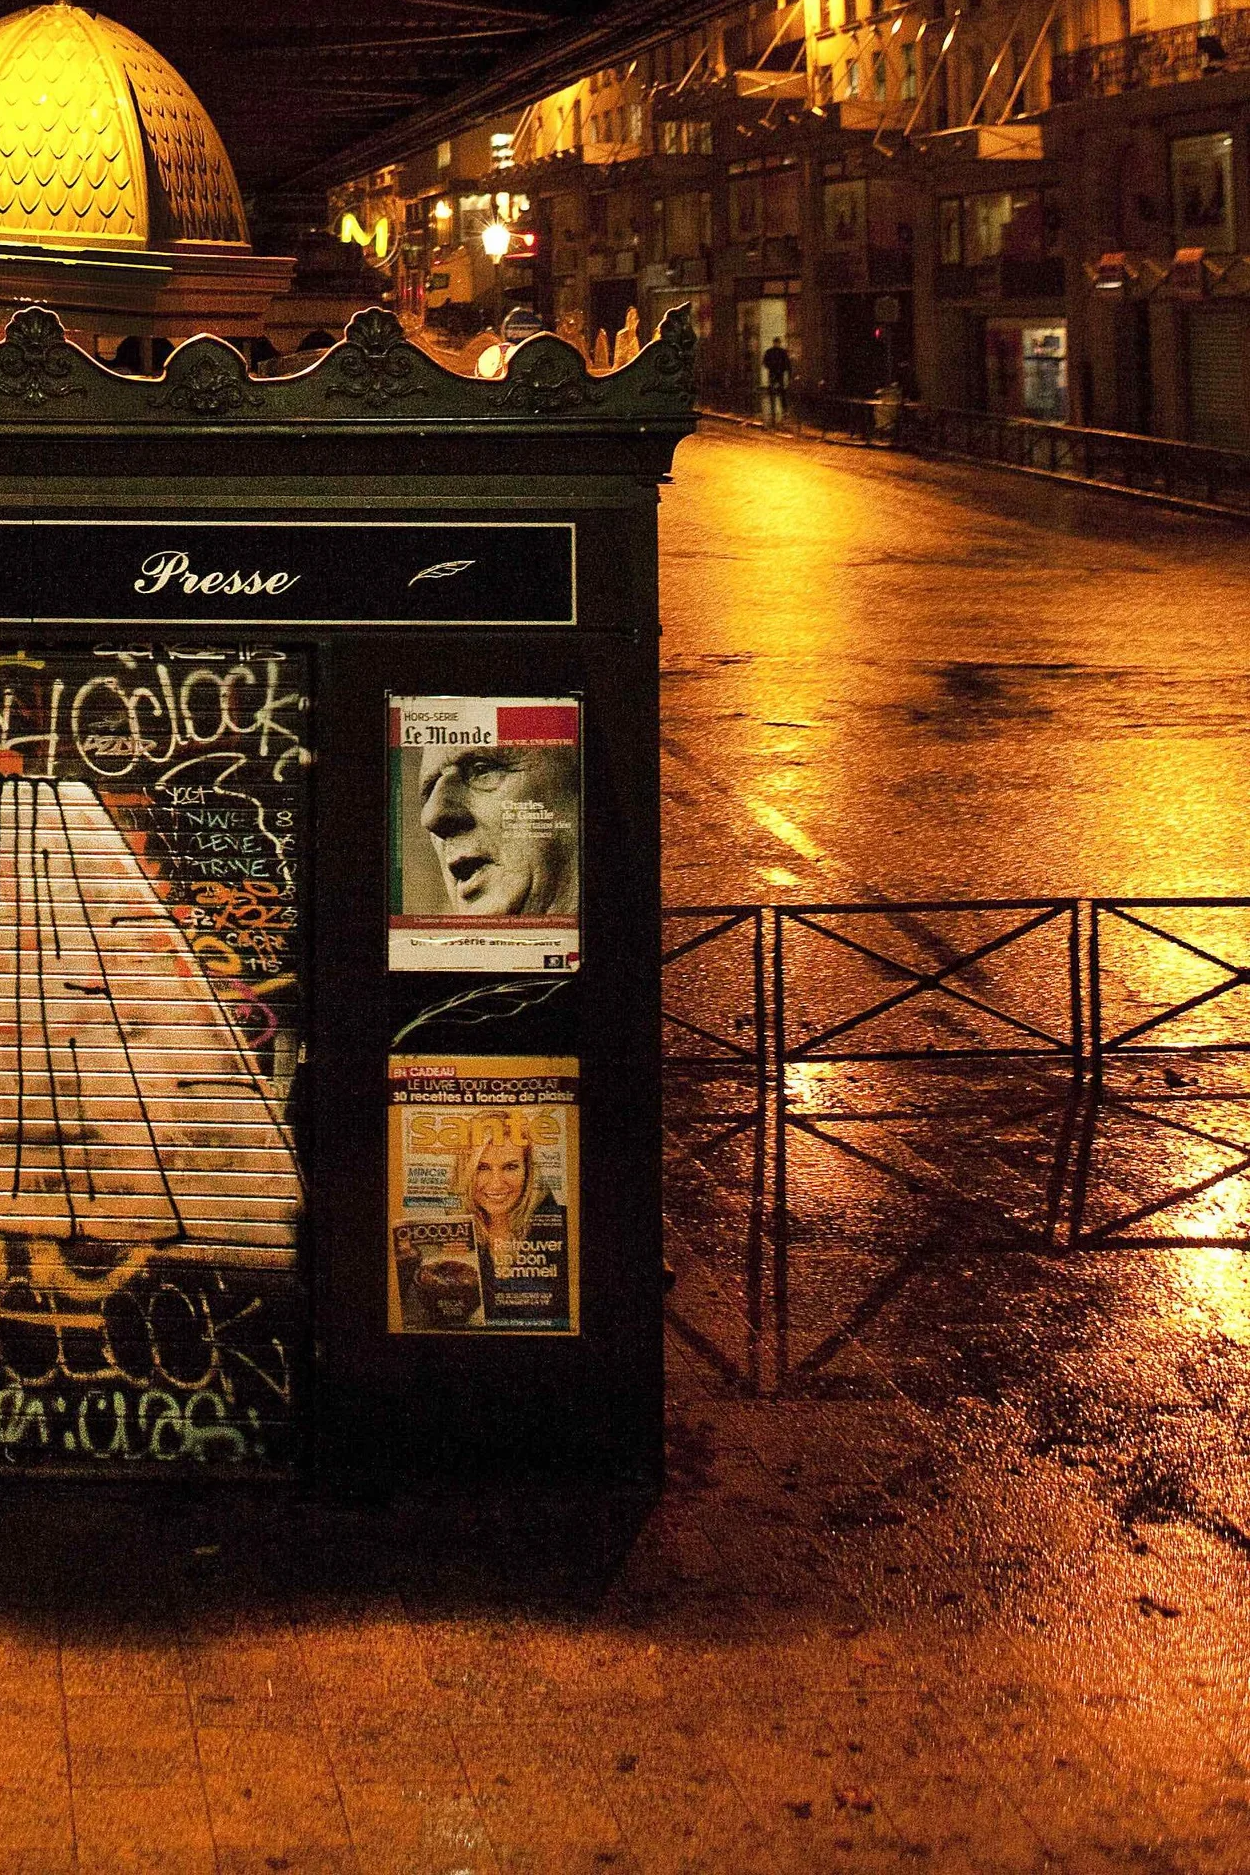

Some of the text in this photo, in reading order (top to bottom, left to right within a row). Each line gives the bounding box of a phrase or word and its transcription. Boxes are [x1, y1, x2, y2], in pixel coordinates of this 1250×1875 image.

[133, 550, 301, 597] Presse
[404, 725, 492, 745] Le Monde
[409, 1067, 456, 1077] CADEAU
[407, 1079, 559, 1091] LE LIVRE TOUT CHOCOLAT
[392, 1090, 576, 1103] 30 recettes à fondre de plaisir
[410, 1108, 561, 1148] santé
[396, 1222, 470, 1240] CHOCOLAT
[494, 1239, 563, 1252] Retrouver
[515, 1252, 547, 1265] bon
[494, 1265, 558, 1278] sommeil
